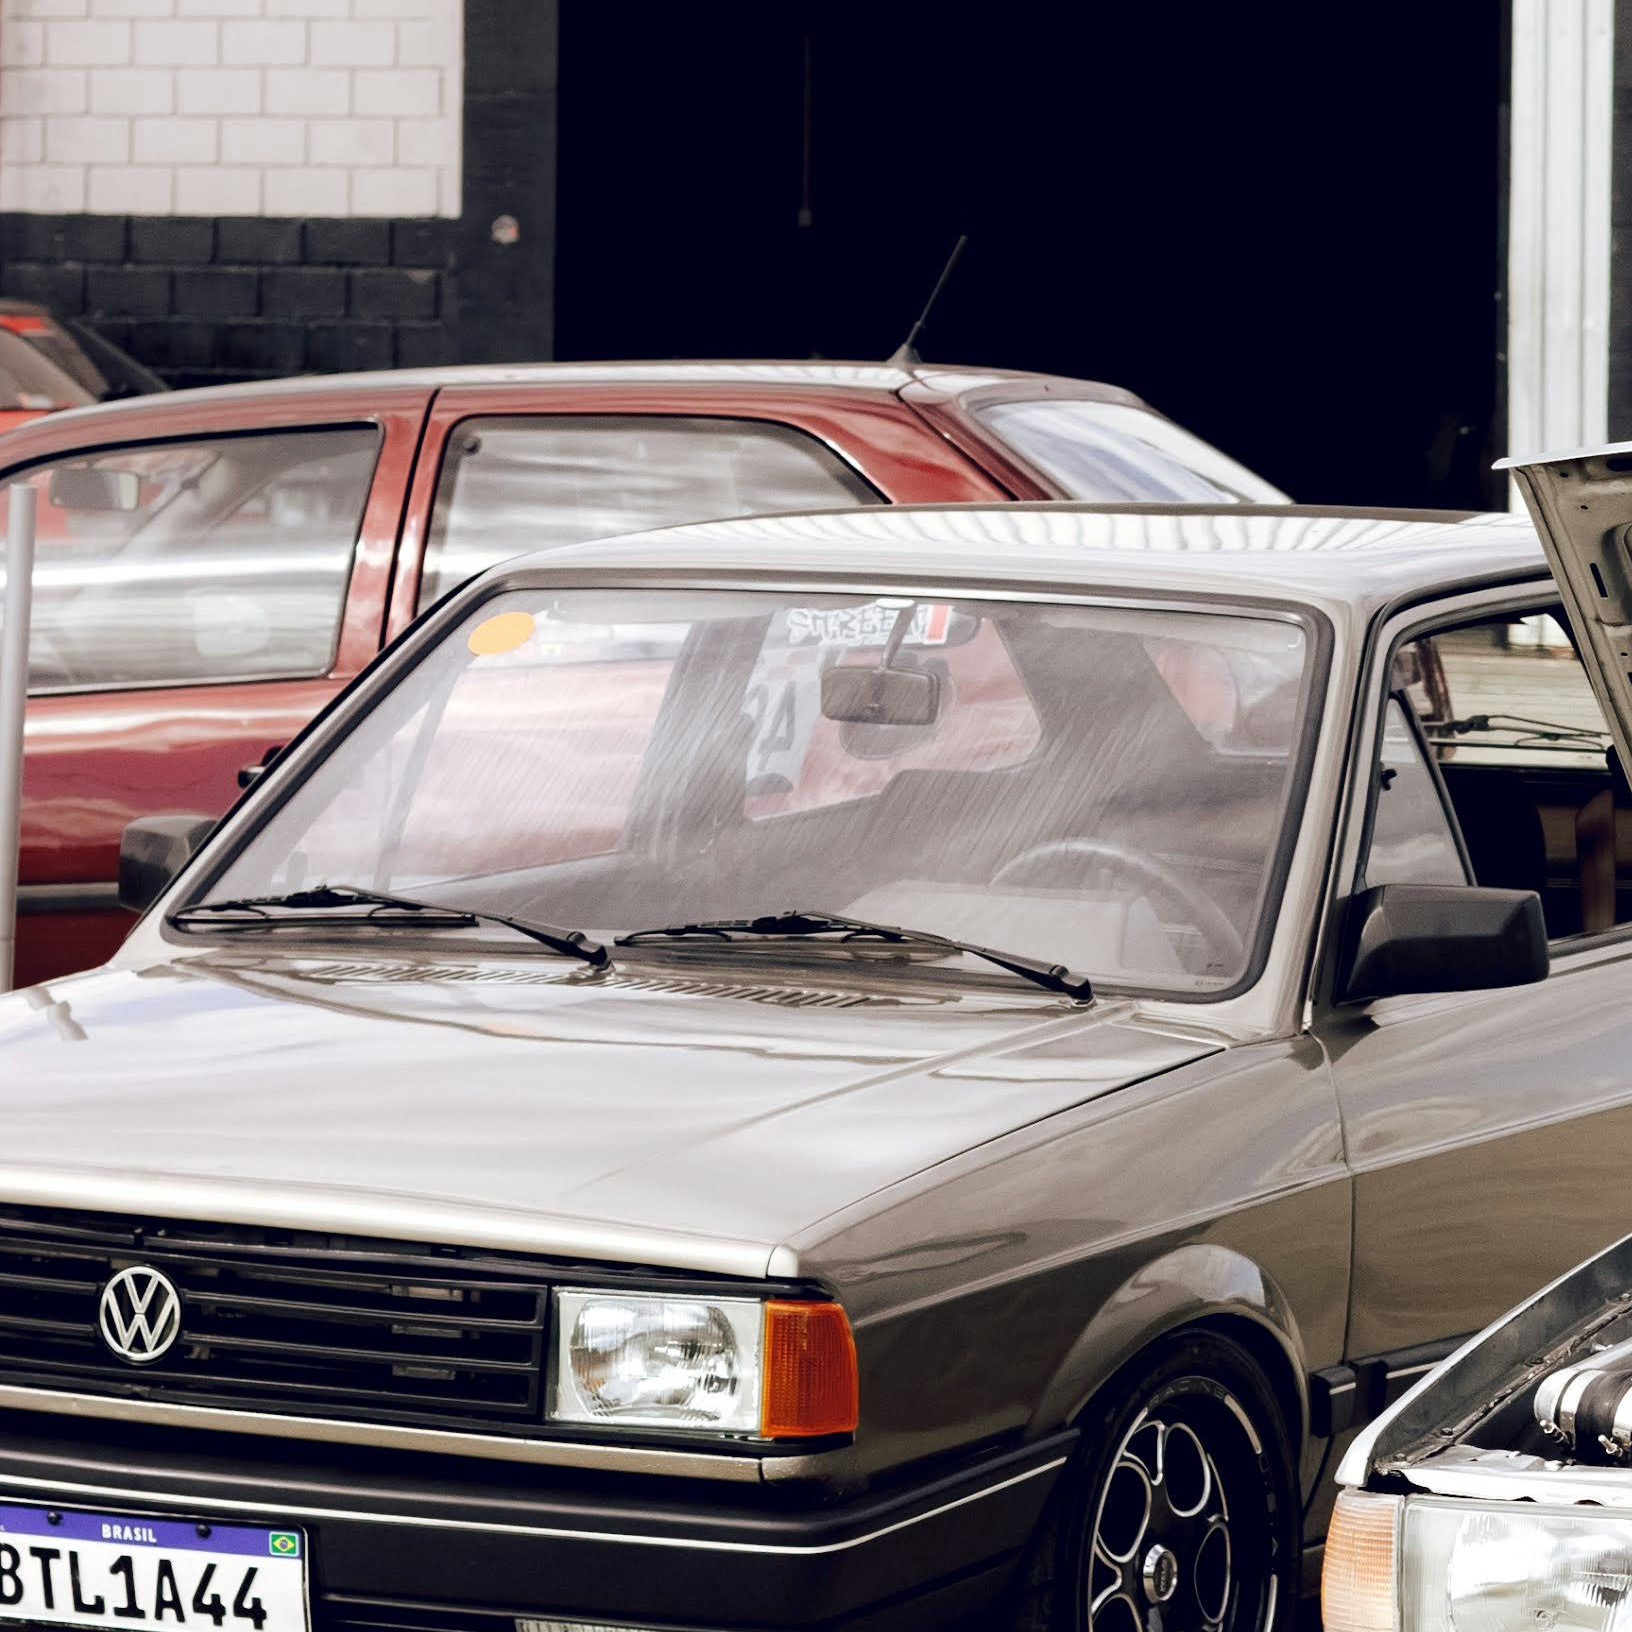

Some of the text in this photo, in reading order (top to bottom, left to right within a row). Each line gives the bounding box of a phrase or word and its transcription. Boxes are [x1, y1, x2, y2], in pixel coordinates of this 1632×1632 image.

[101, 1267, 180, 1360] VW
[102, 1524, 157, 1543] BRASIL
[0, 1543, 267, 1630] BTL1A44
